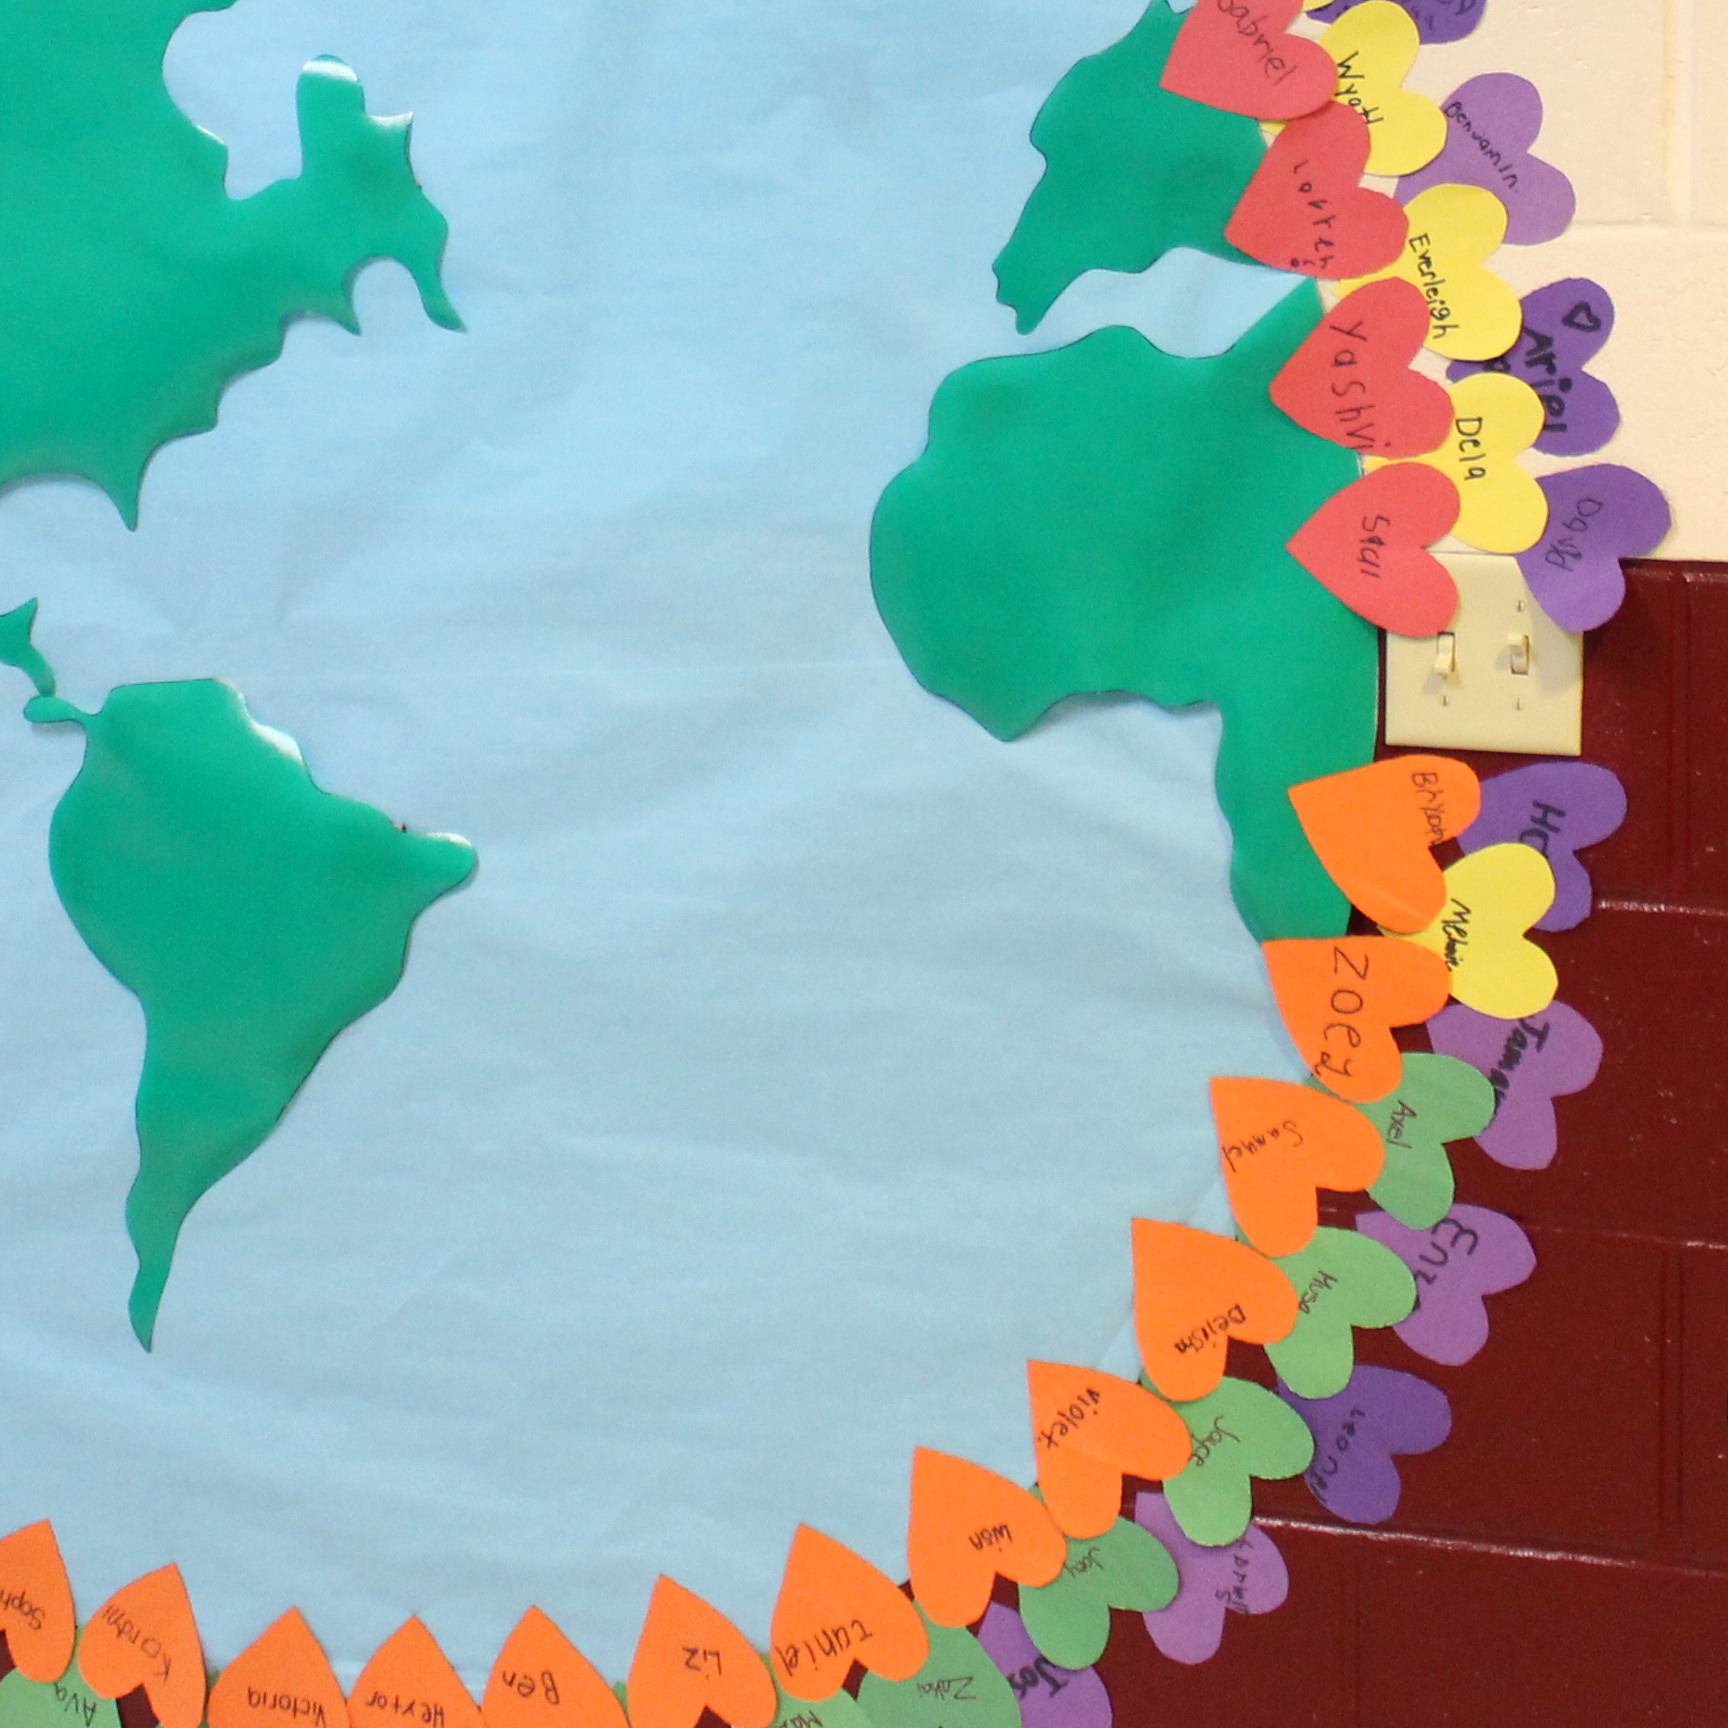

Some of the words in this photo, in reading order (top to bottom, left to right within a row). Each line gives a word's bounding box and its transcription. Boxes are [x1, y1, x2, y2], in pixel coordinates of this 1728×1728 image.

[1409, 232, 1459, 339] Everleigh
[1386, 1099, 1417, 1150] Axel
[502, 1670, 560, 1706] Ben
